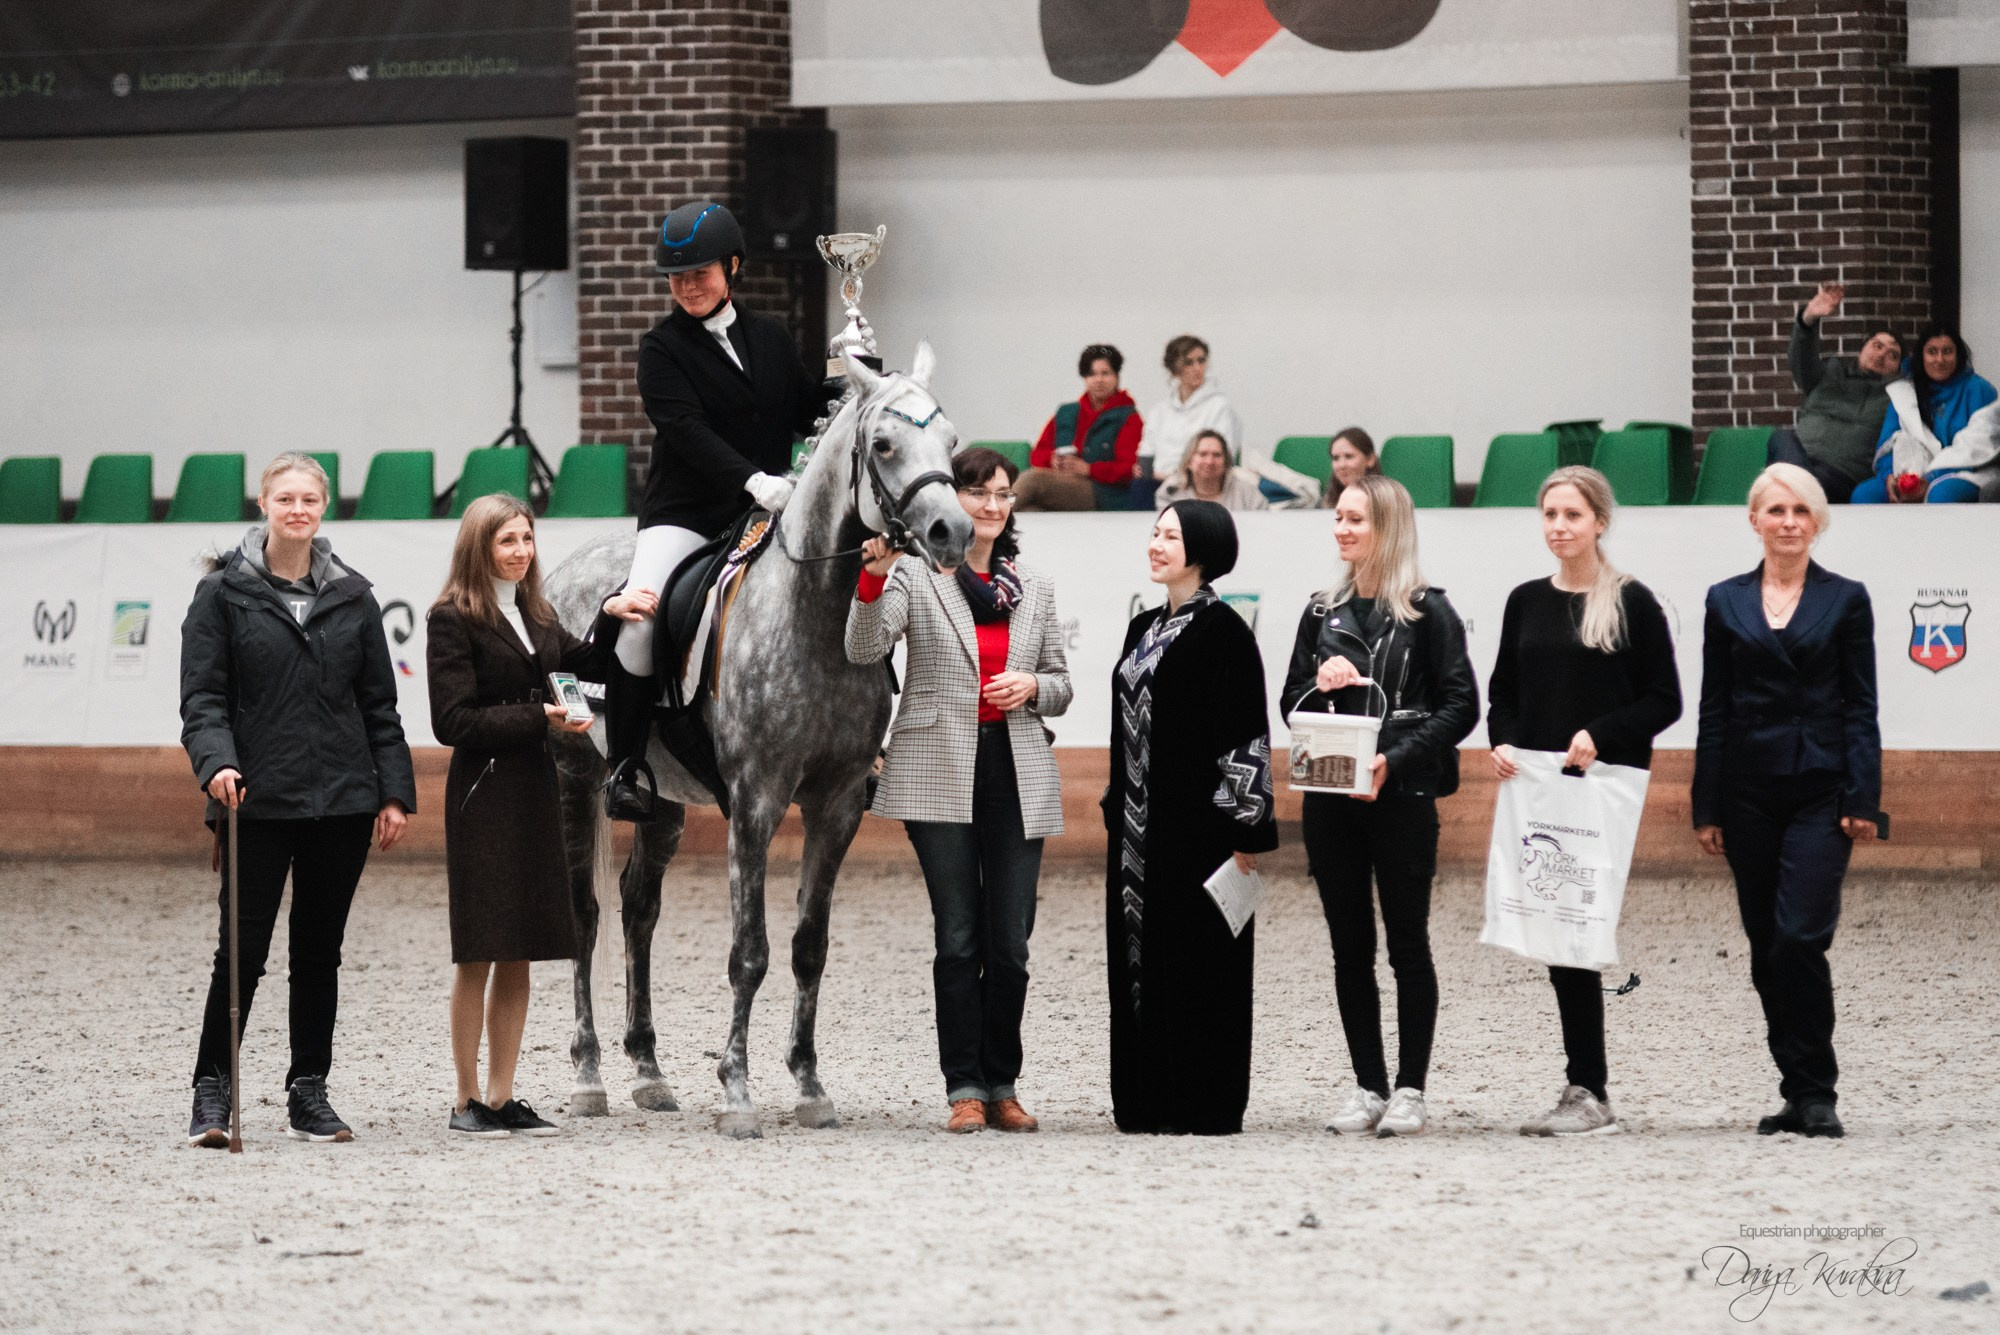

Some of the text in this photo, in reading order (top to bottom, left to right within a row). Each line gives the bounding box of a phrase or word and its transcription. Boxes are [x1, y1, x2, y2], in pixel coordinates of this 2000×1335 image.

[1527, 821, 1600, 838] YORKMARKET.RU
[1545, 851, 1579, 866] YORK
[1542, 862, 1597, 879] MARKET
